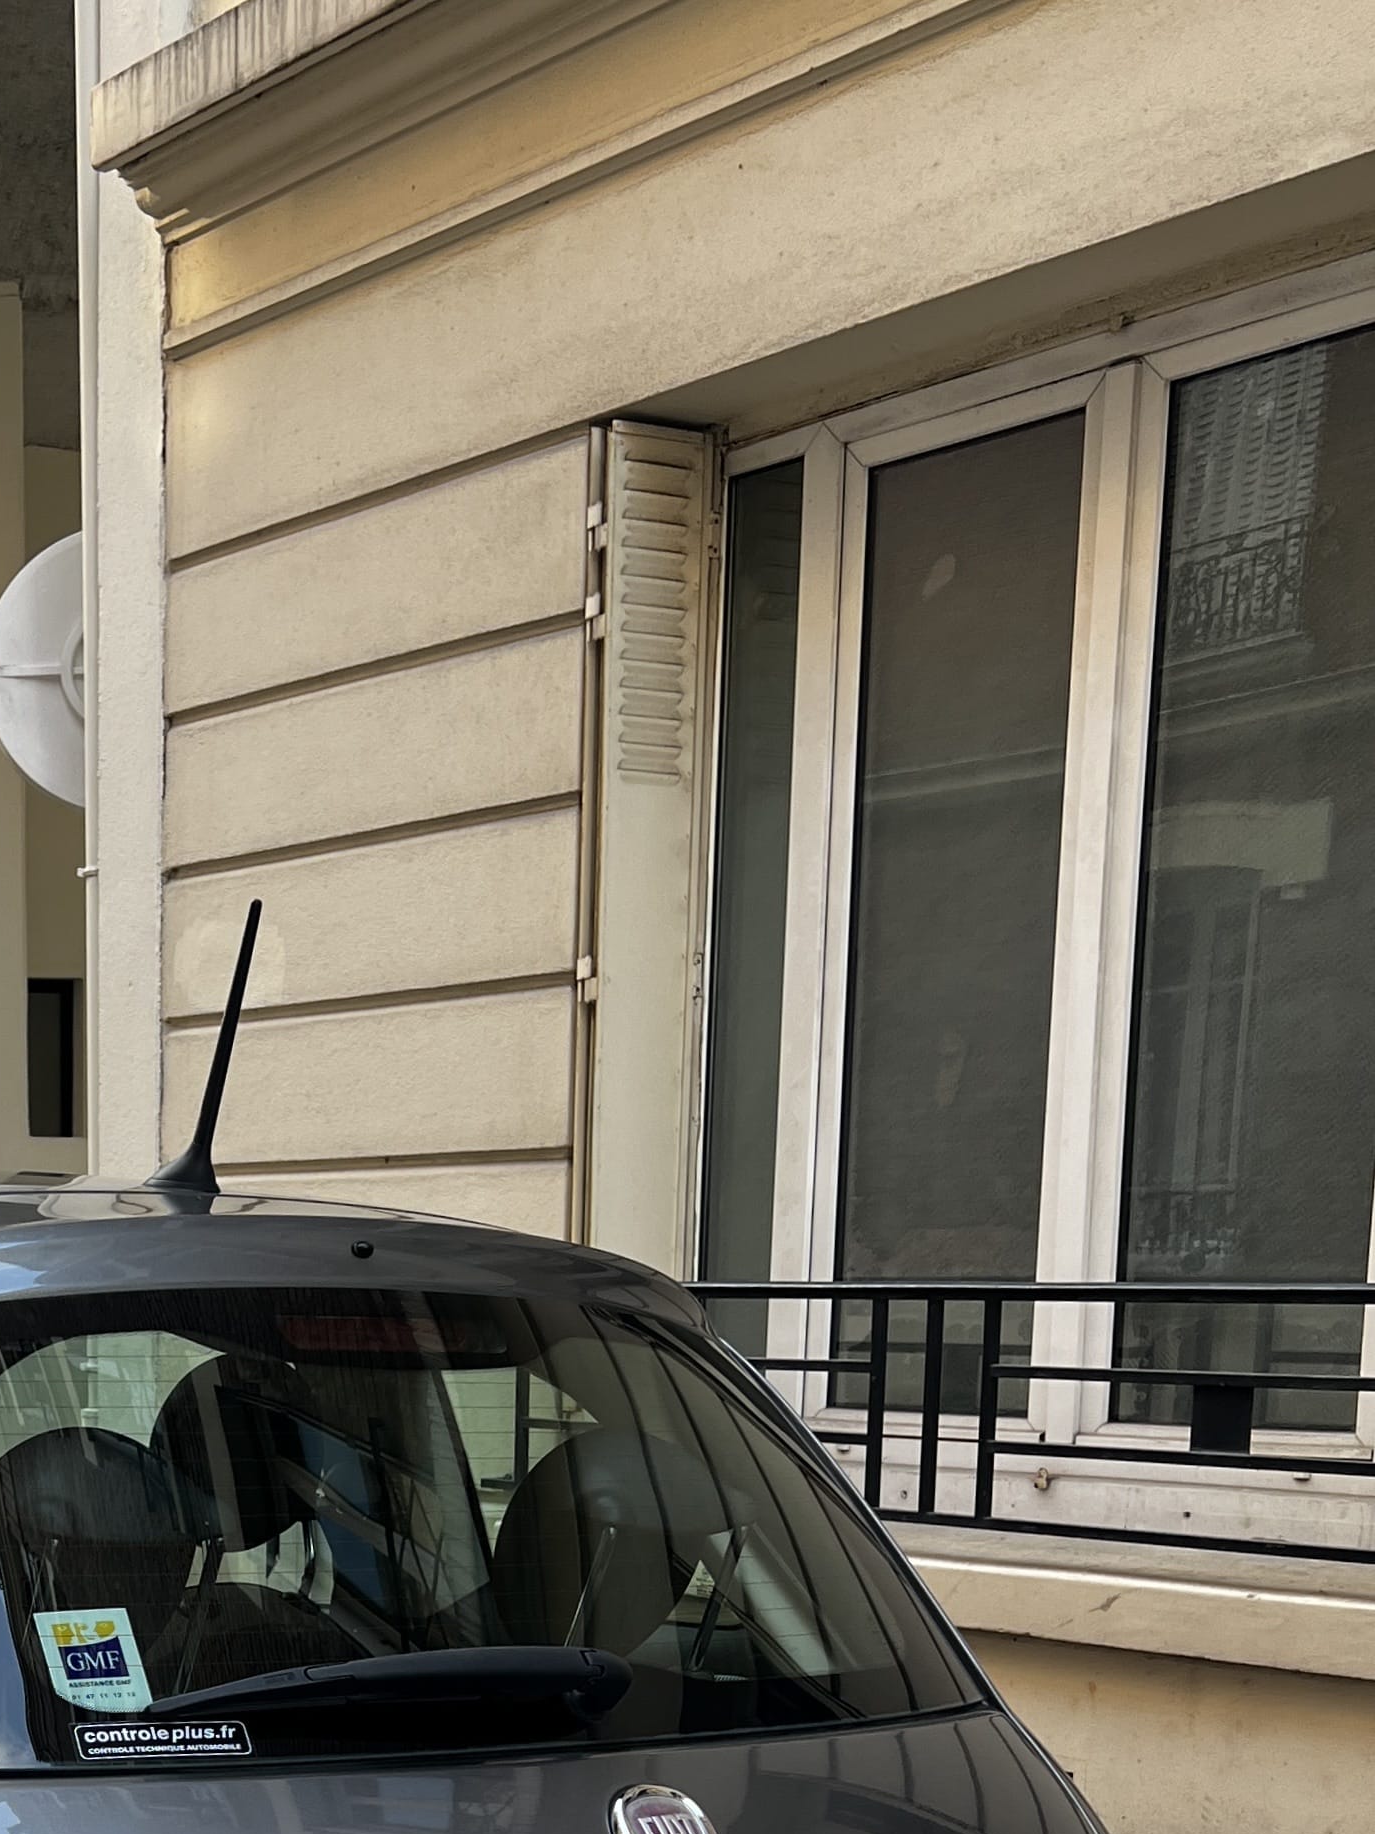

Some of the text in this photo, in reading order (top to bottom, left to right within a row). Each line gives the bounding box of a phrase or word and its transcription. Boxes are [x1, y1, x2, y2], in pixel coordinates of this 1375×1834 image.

[66, 1650, 120, 1672] GMF
[68, 1680, 114, 1688] ASSISTANCE
[186, 1743, 241, 1751] AUTOMOBILE
